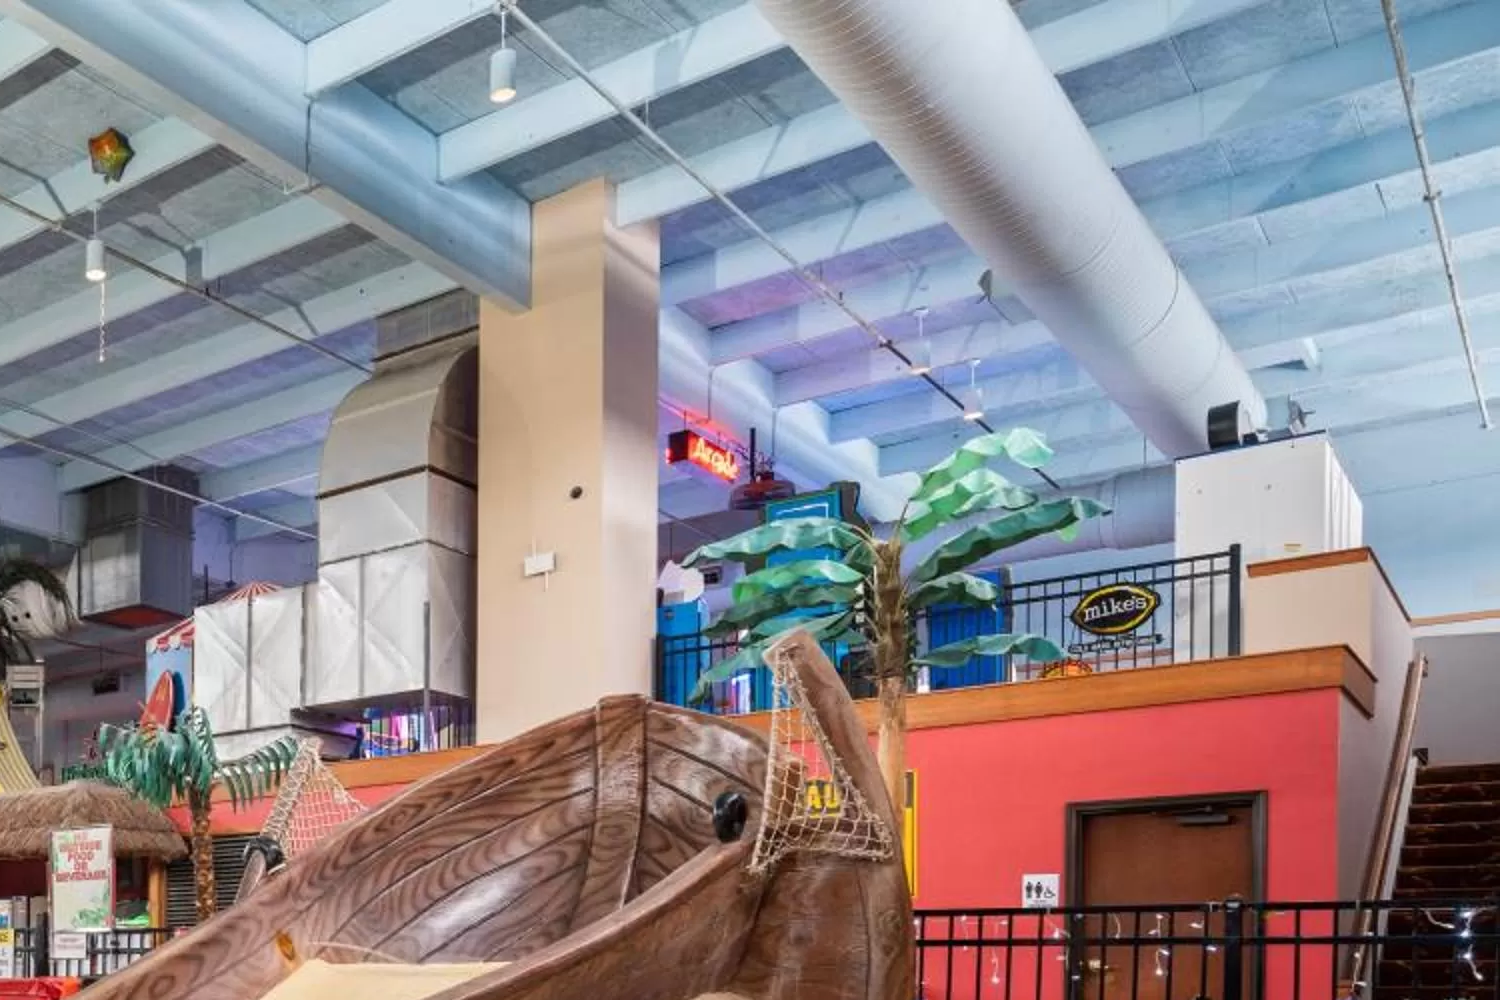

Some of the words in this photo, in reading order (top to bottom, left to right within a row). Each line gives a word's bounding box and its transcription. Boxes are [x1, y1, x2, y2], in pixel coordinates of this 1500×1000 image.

[692, 436, 739, 479] Arcade
[1084, 595, 1147, 623] mike's
[67, 851, 94, 862] FOOD
